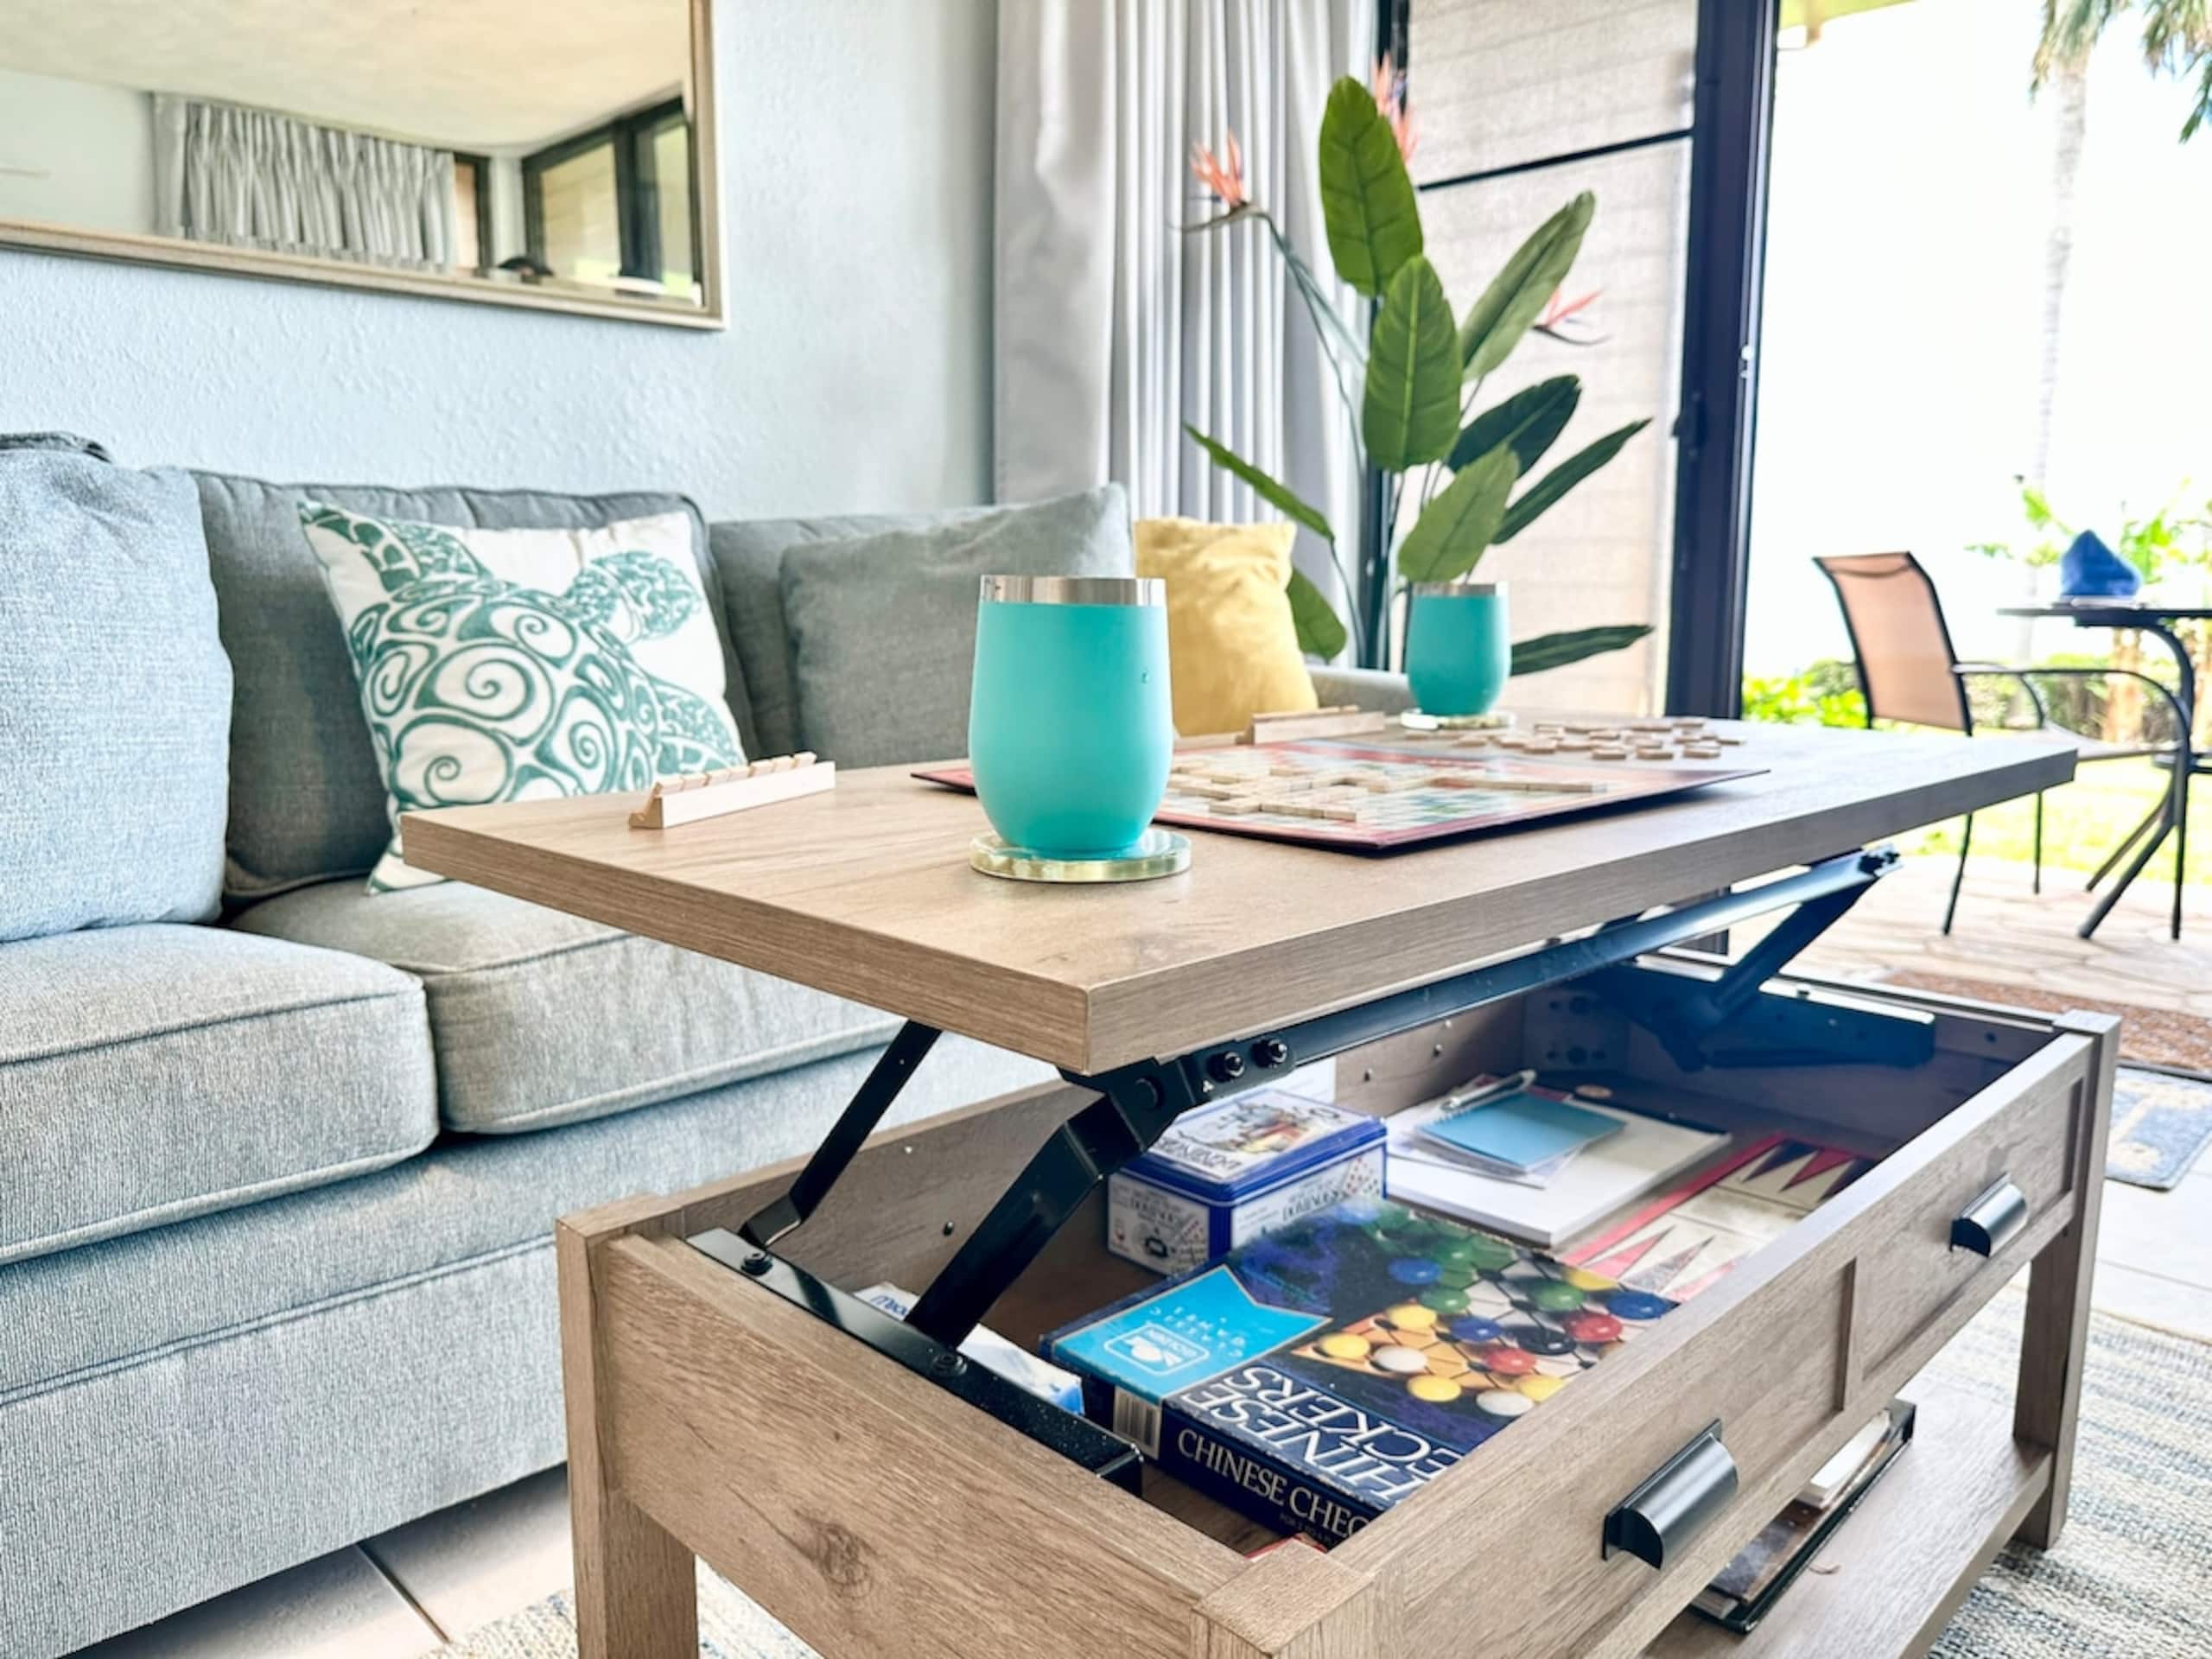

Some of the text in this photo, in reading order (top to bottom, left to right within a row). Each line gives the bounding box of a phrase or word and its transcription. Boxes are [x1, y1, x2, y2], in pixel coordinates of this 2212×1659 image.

[1181, 1383, 1427, 1502] HINESE
[1224, 1367, 1464, 1479] ECKERS
[1178, 1428, 1287, 1507] CHINESE
[1289, 1486, 1370, 1539] CHEC
